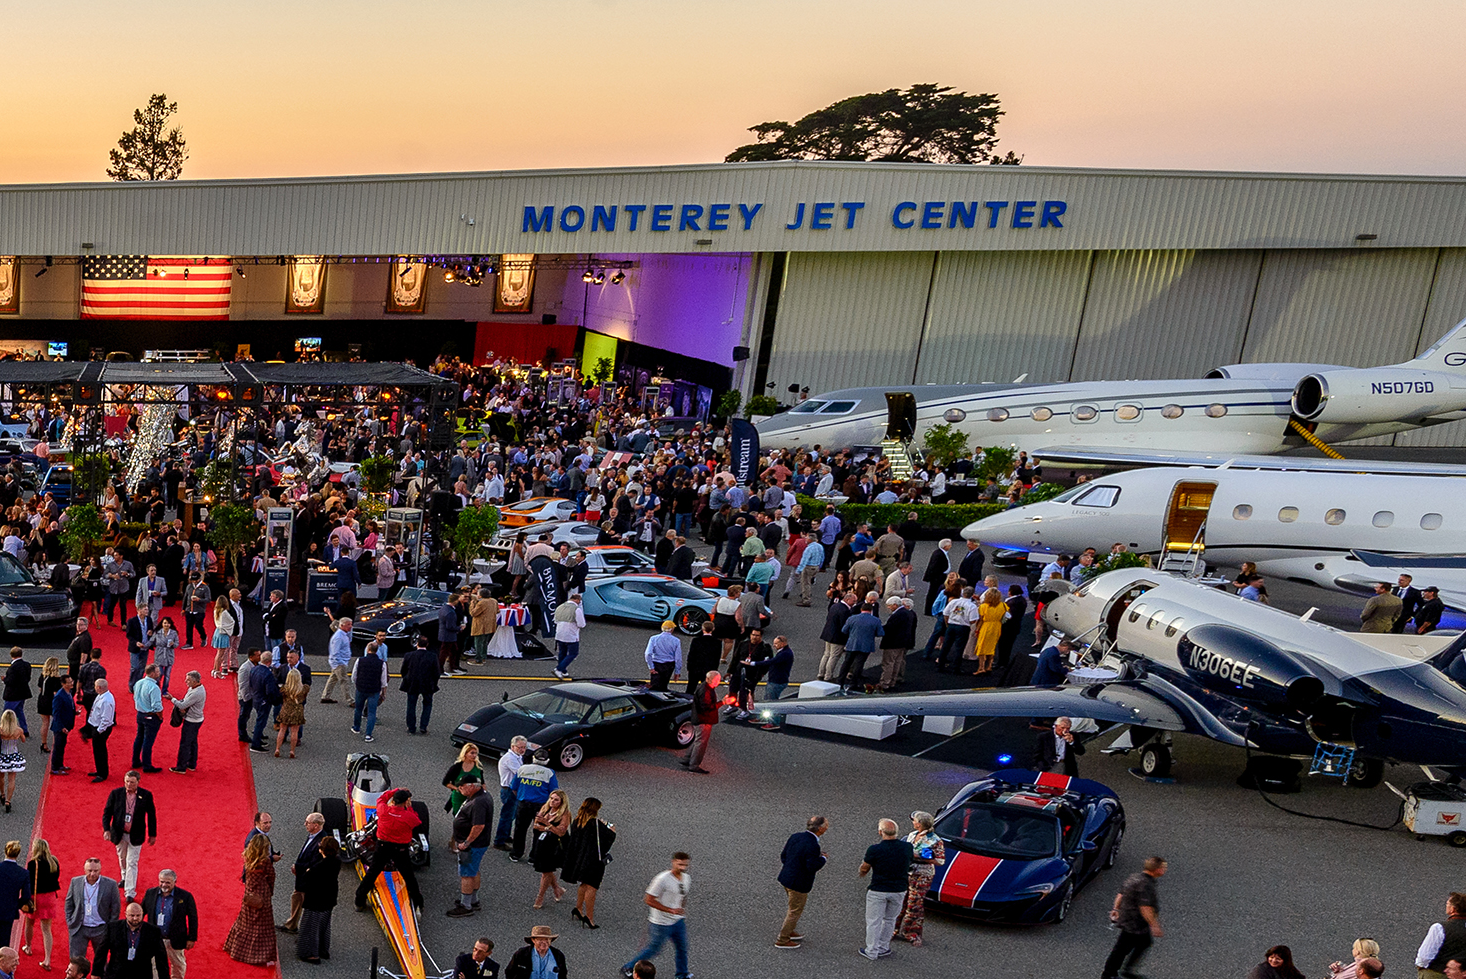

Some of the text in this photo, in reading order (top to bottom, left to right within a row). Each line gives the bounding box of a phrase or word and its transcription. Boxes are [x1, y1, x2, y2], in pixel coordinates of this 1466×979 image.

[522, 200, 1068, 233] MONTEREY JET CENTER
[1371, 381, 1434, 394] N507GD
[1189, 646, 1261, 689] N306EE
